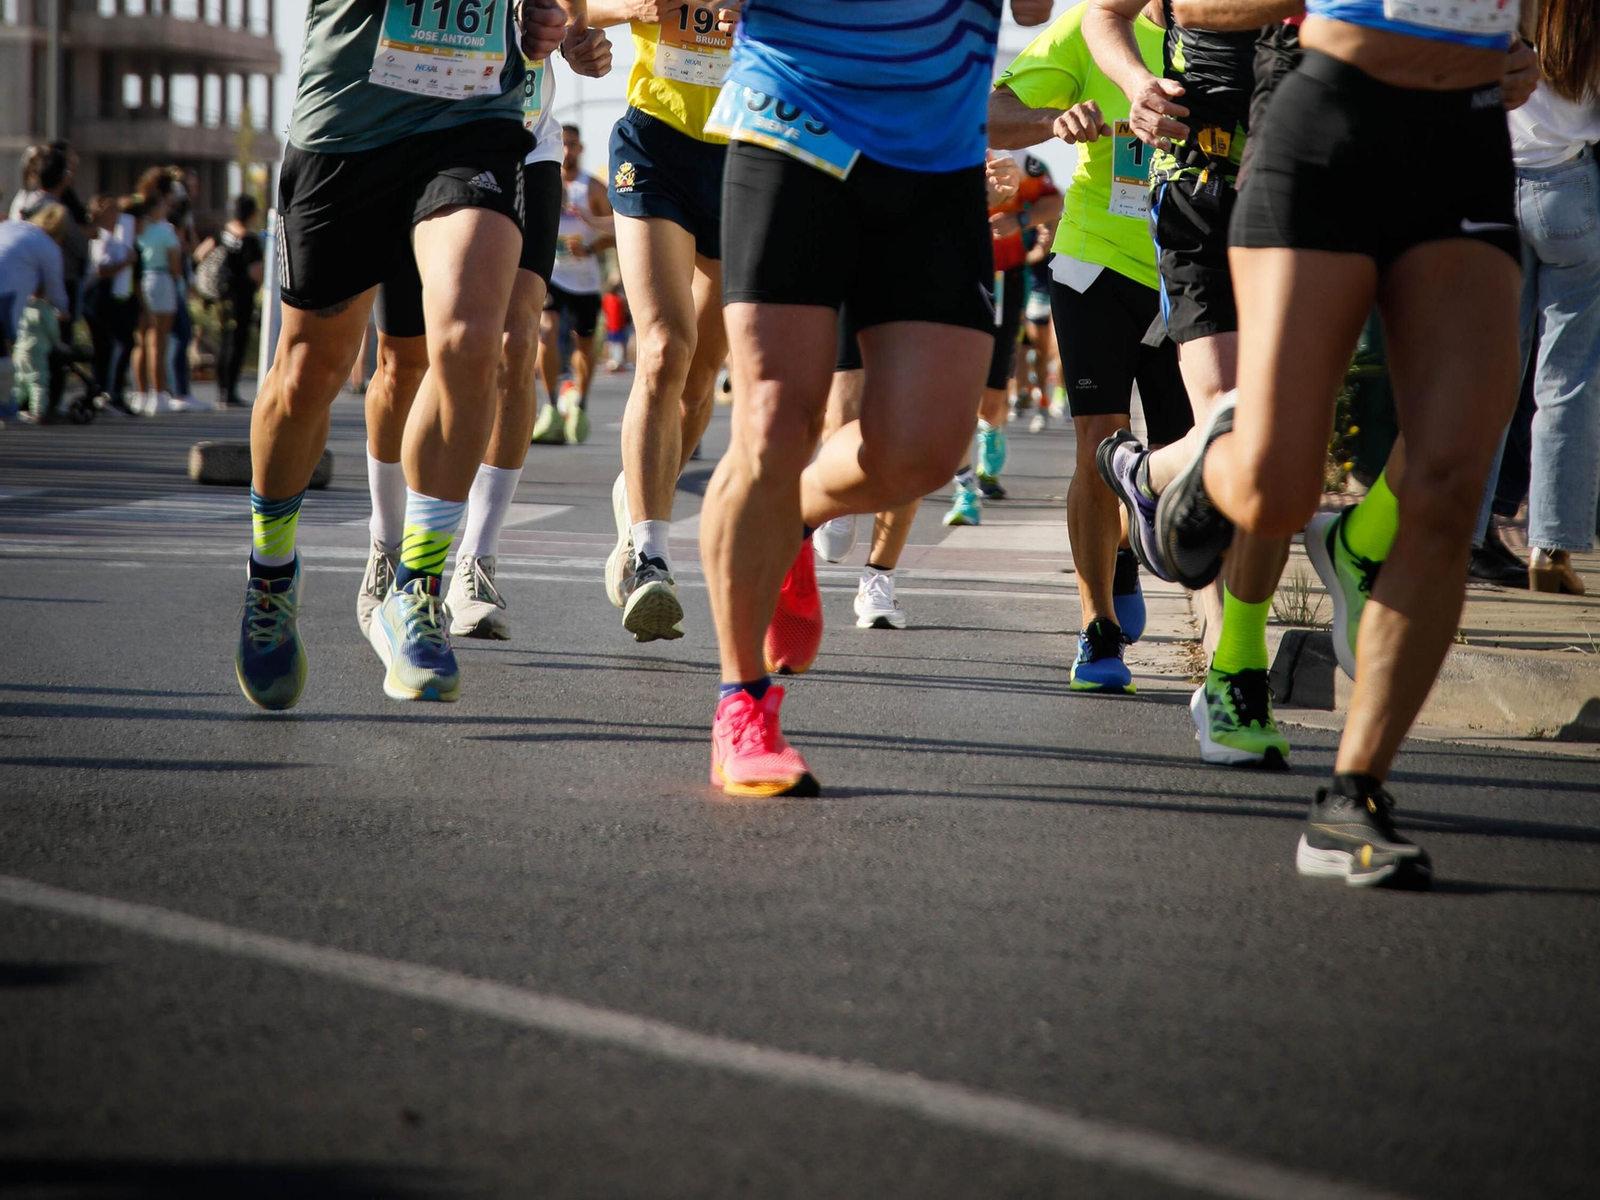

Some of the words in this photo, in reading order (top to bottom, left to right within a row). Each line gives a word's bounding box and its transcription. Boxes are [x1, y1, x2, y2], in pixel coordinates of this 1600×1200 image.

[441, 33, 485, 47] ANTONIO
[695, 35, 727, 46] BRUNO
[415, 63, 438, 73] NEXAL
[468, 180, 502, 193] adidas
